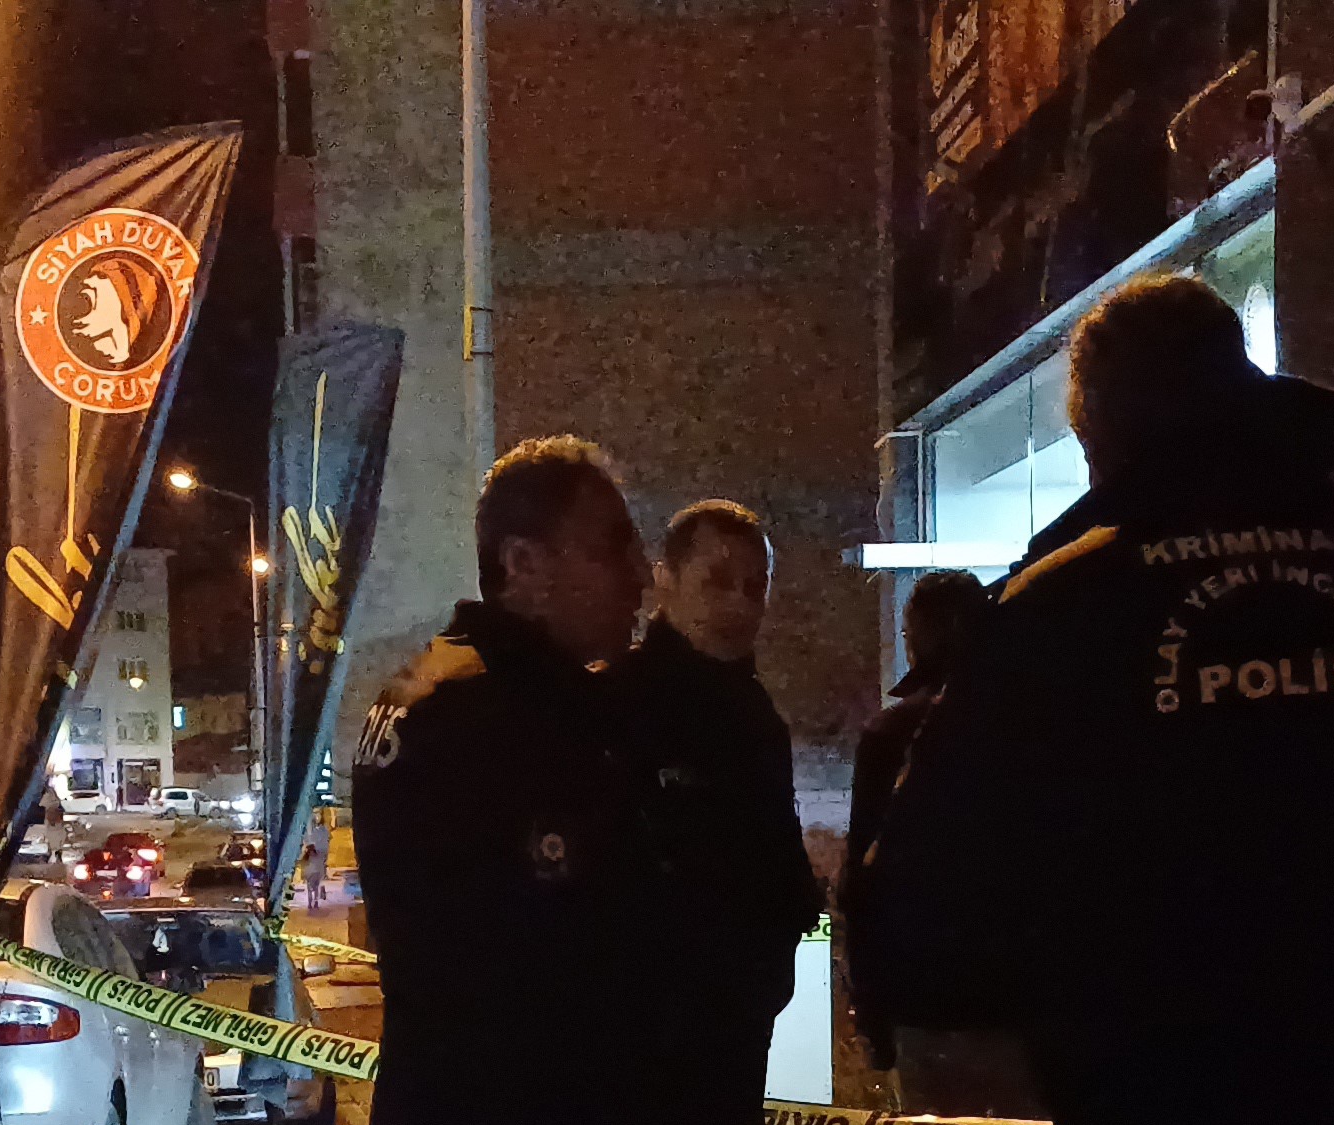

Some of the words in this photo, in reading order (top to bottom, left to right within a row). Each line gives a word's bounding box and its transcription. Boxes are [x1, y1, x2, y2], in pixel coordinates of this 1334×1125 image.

[106, 978, 159, 1014] POLİS
[178, 1003, 279, 1047] GİRİLMEZ
[300, 1032, 375, 1070] POLİS
